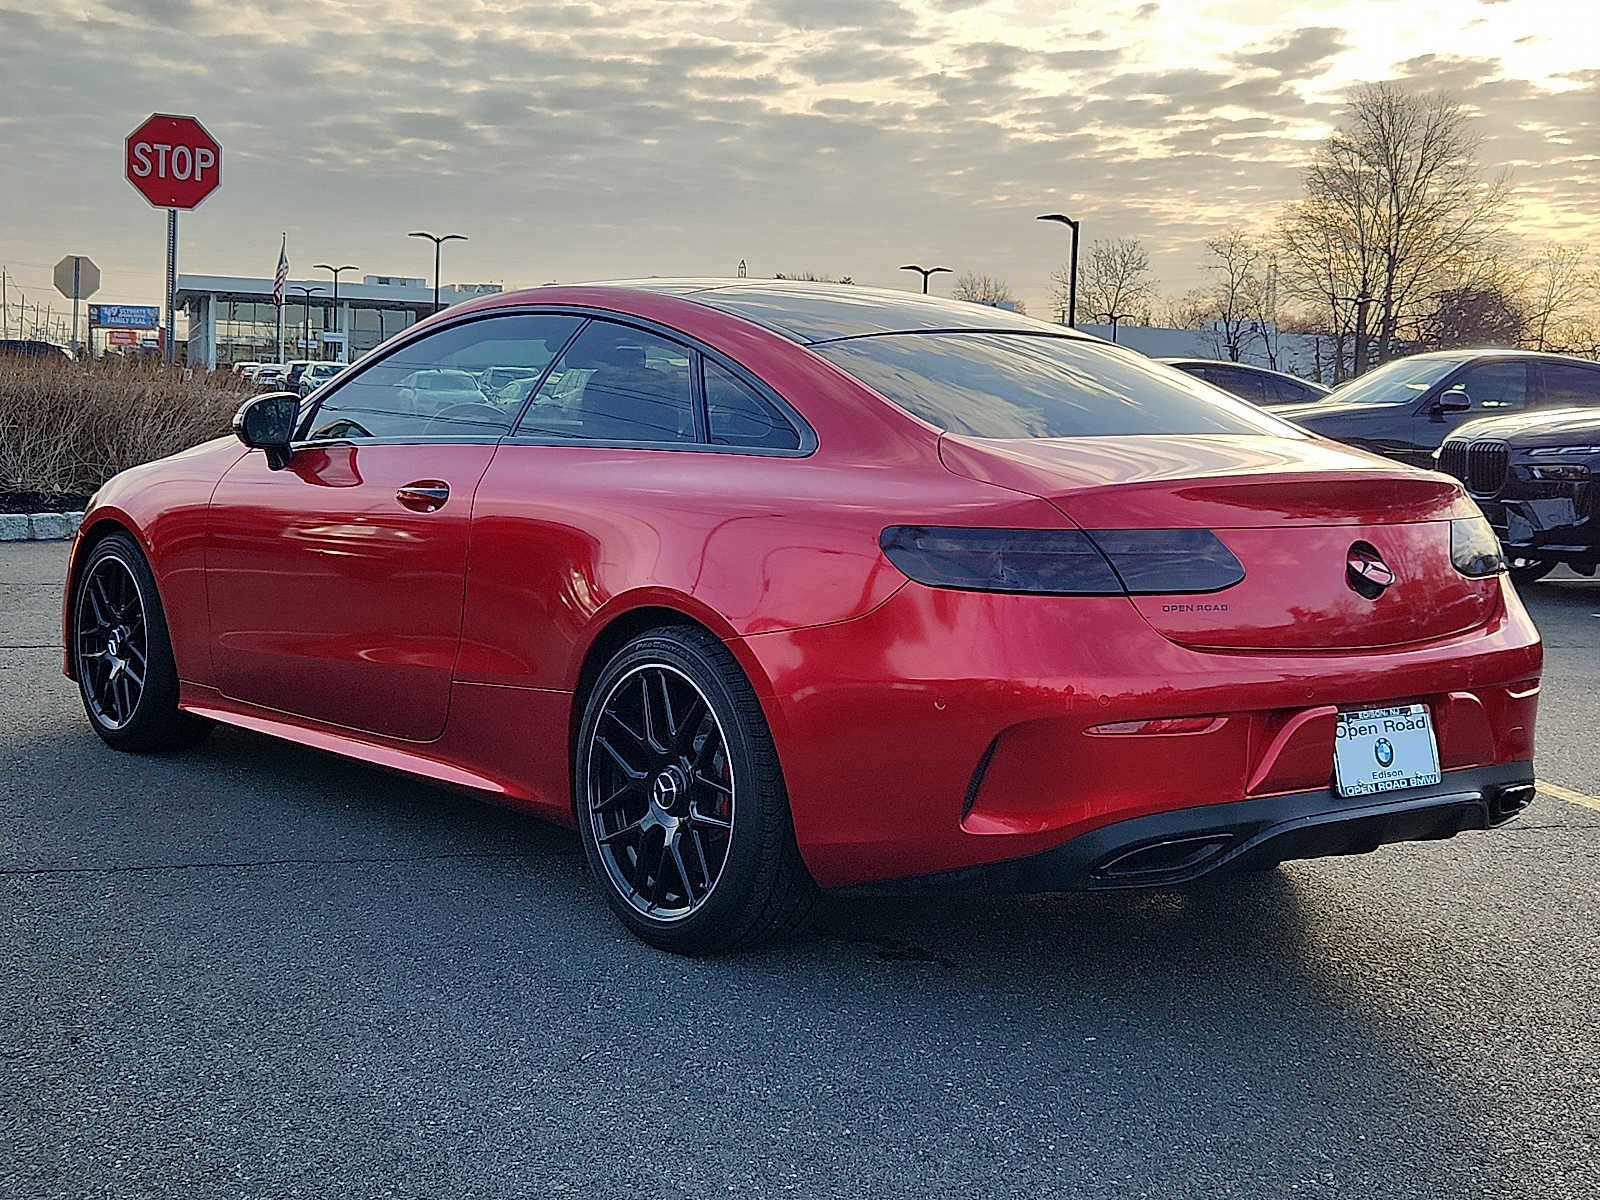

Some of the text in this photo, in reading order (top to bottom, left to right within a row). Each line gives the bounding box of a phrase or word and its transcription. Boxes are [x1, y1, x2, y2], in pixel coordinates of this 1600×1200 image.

[132, 142, 215, 181] STOP
[1162, 604, 1228, 612] OPEN ROAD
[1336, 717, 1426, 740] Open Road
[1372, 770, 1403, 779] Edison
[1346, 775, 1436, 795] OPEN ROAD BMW
